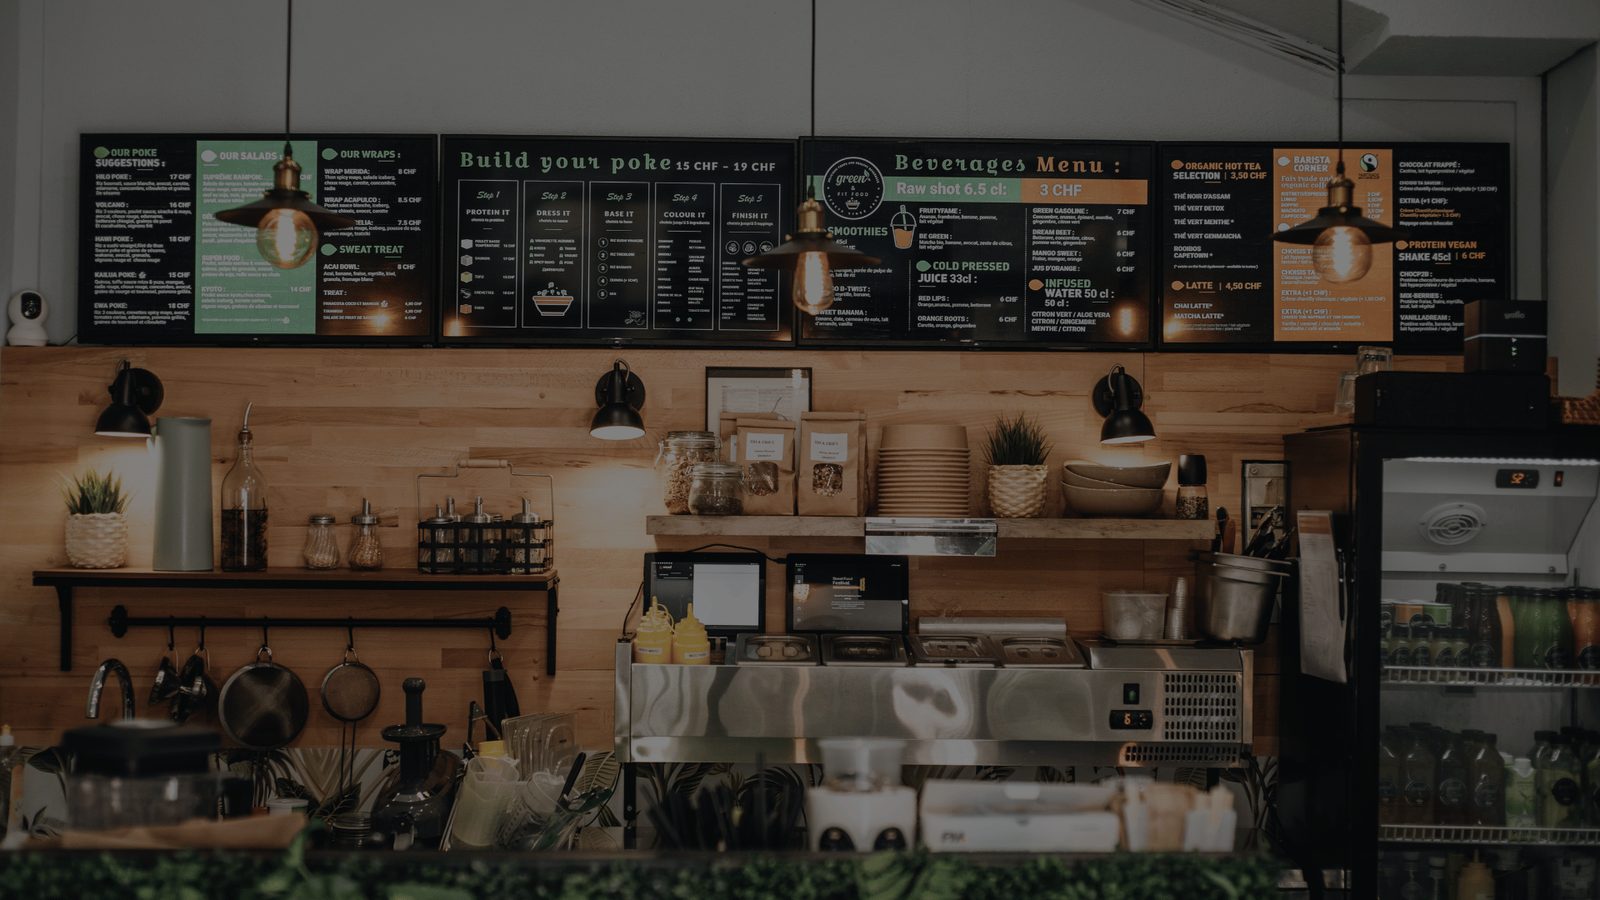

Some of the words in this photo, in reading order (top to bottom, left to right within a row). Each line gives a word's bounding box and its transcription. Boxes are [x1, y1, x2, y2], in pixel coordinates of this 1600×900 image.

[460, 152, 529, 168] Build
[540, 156, 599, 172] your
[611, 154, 671, 174] poke
[676, 162, 689, 170] 15
[694, 162, 718, 170] CHF
[734, 162, 748, 171] 19
[752, 163, 775, 171] CHF
[896, 155, 1026, 176] Beverages
[1036, 156, 1103, 172] Menu
[836, 174, 868, 186] green
[897, 183, 927, 194] Raw
[930, 182, 960, 194] shot
[964, 183, 986, 195] 6.5
[990, 183, 1007, 195] cl:
[1040, 185, 1049, 196] 3
[1053, 185, 1082, 196] CHF
[607, 192, 624, 201] Step
[828, 227, 888, 236] SMOOTHIES
[933, 262, 959, 271] COLD
[962, 262, 1010, 271] PRESSED
[918, 274, 947, 283] JUICE
[950, 274, 971, 283] 33cl
[1046, 279, 1091, 288] INFUSED
[1046, 289, 1082, 298] WATER
[1085, 290, 1096, 298] 50
[1100, 289, 1108, 298] cl
